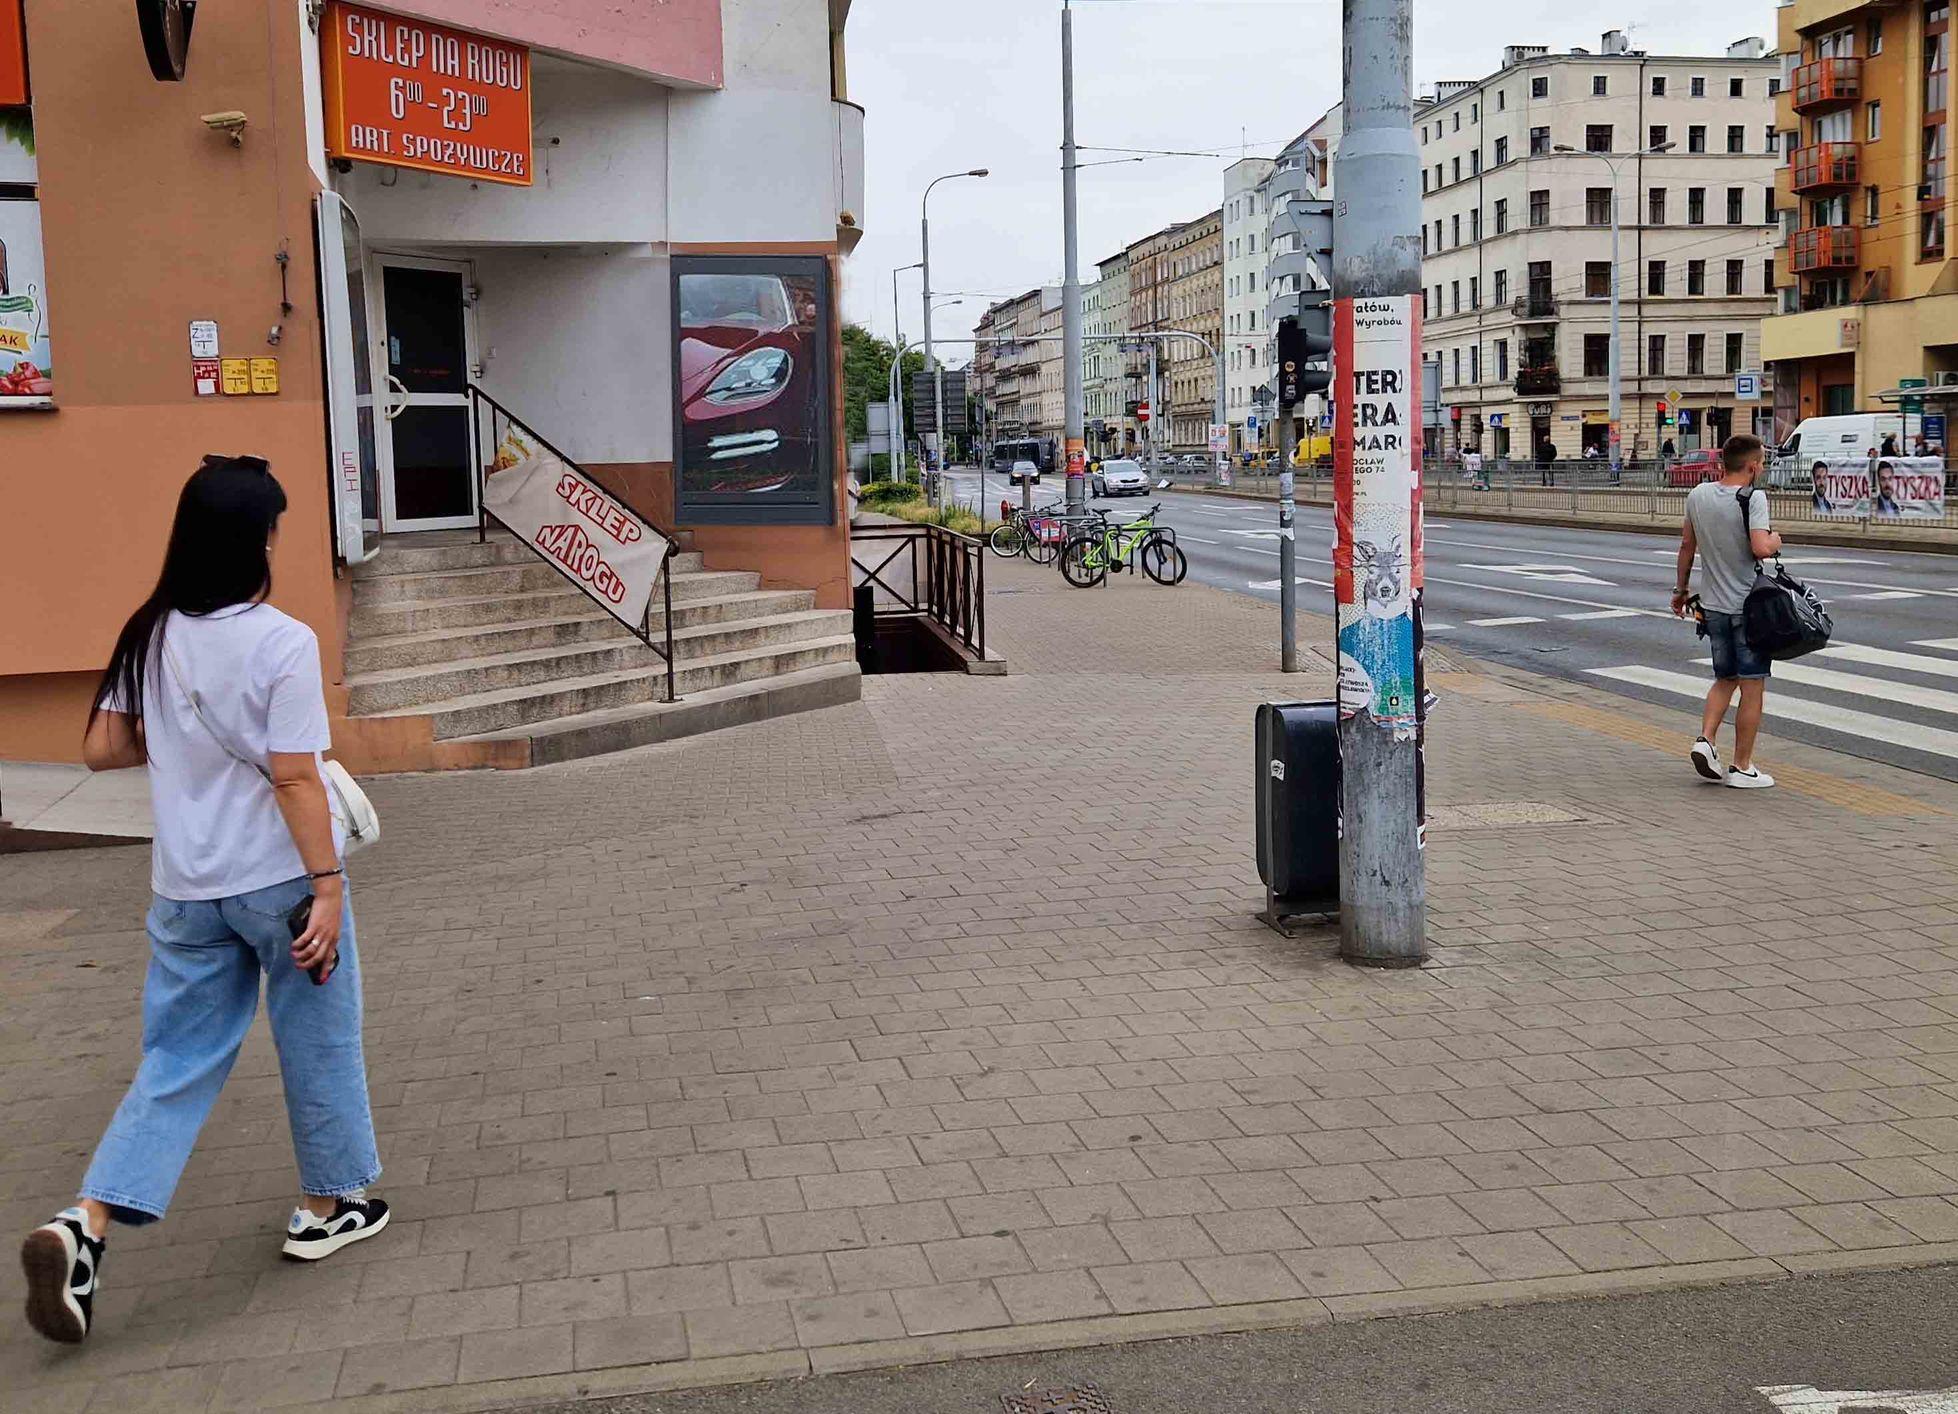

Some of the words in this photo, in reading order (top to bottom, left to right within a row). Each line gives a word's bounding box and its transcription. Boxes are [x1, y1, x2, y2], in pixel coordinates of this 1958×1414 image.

[347, 14, 424, 68] SKLEP
[431, 34, 460, 77] NA
[467, 42, 522, 90] ROGU
[351, 124, 395, 154] ART.
[556, 474, 642, 545] SKLEP
[1828, 475, 1870, 499] TYSZKA
